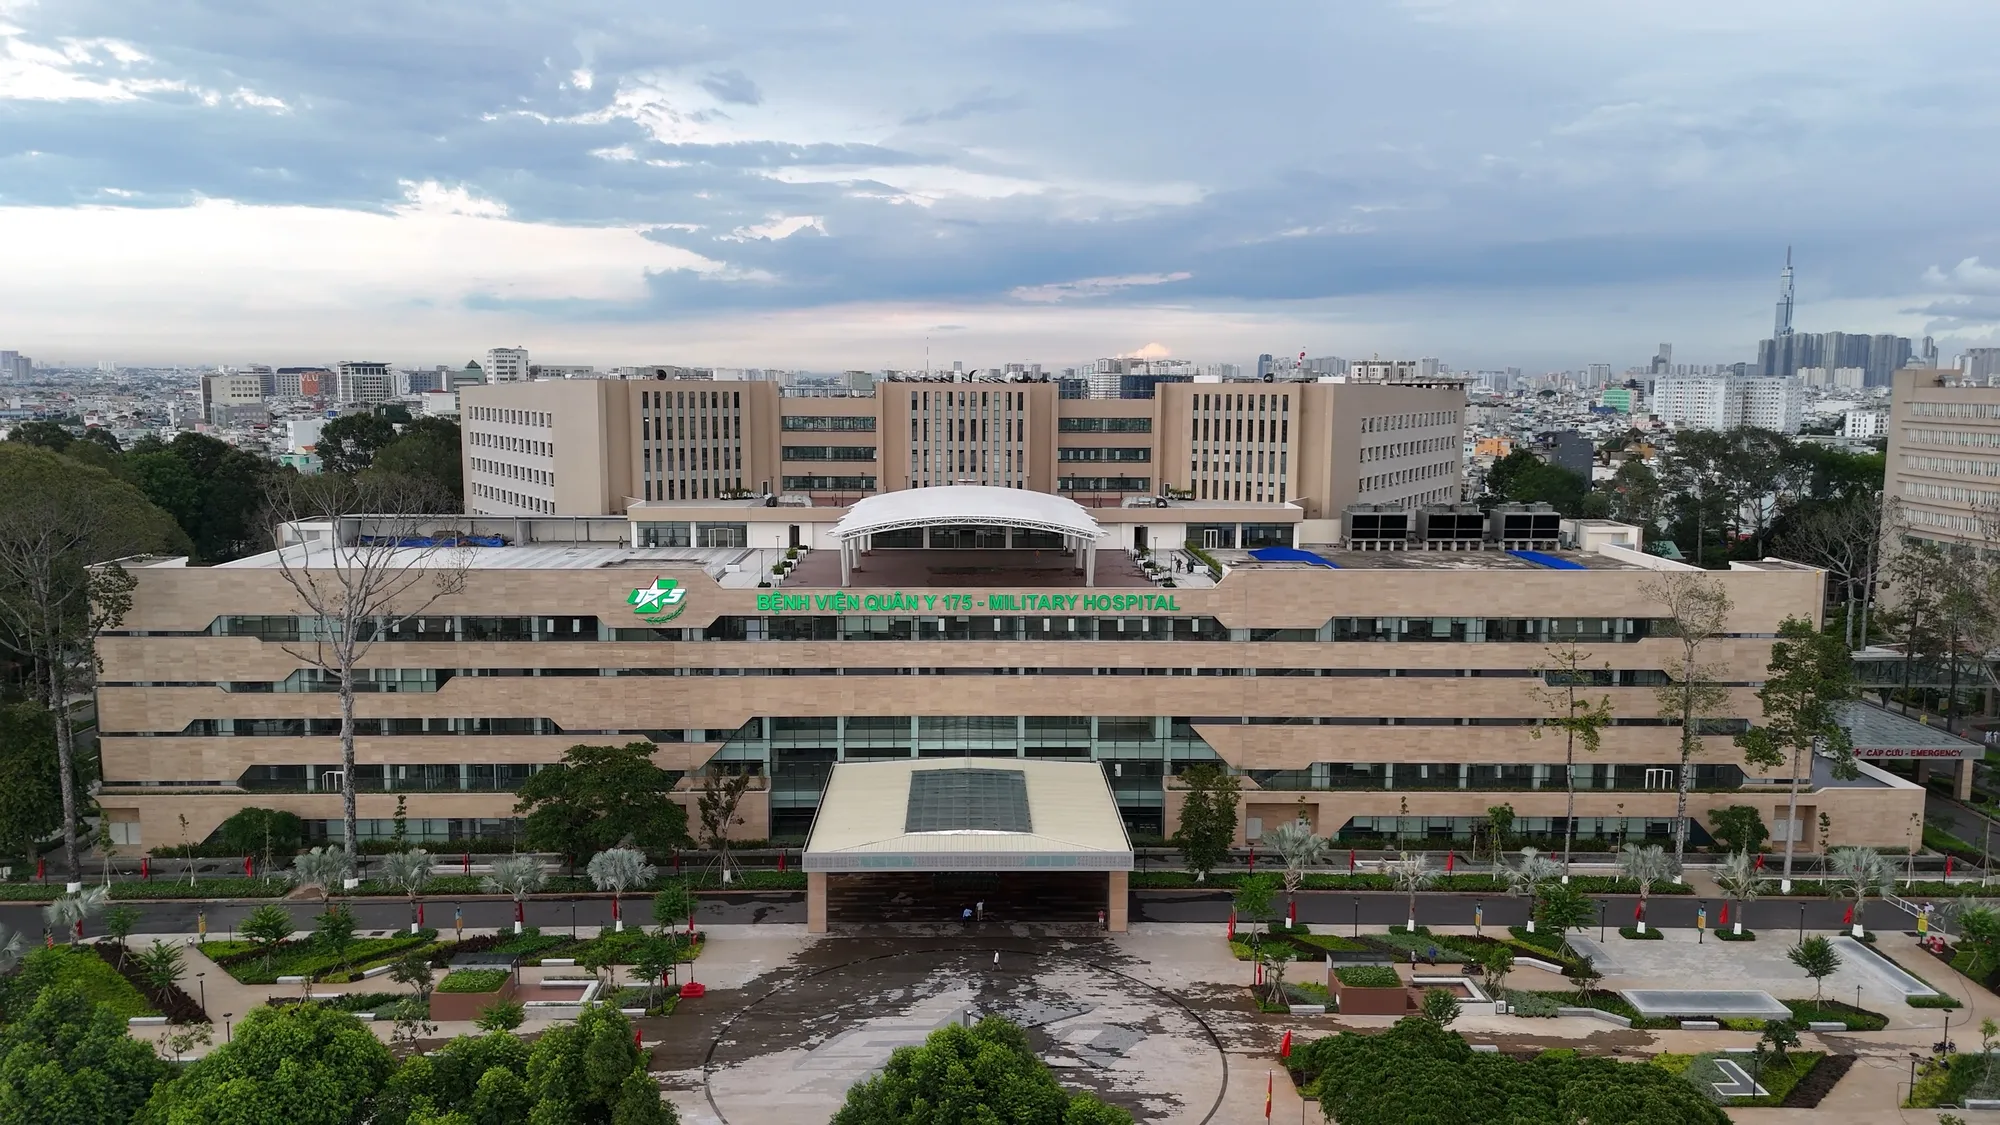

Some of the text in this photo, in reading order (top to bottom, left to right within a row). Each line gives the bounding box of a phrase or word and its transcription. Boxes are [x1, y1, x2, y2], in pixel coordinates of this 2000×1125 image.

[300, 374, 319, 382] VLU
[757, 591, 810, 614] BỆNH
[814, 591, 860, 614] VIỆN
[864, 591, 919, 611] QUÂN
[923, 594, 937, 610] Y
[942, 594, 973, 610] 175
[988, 594, 1079, 611] MILITARY
[1083, 594, 1181, 611] HOSPITAL
[1910, 749, 1963, 757] EMERGENCY
